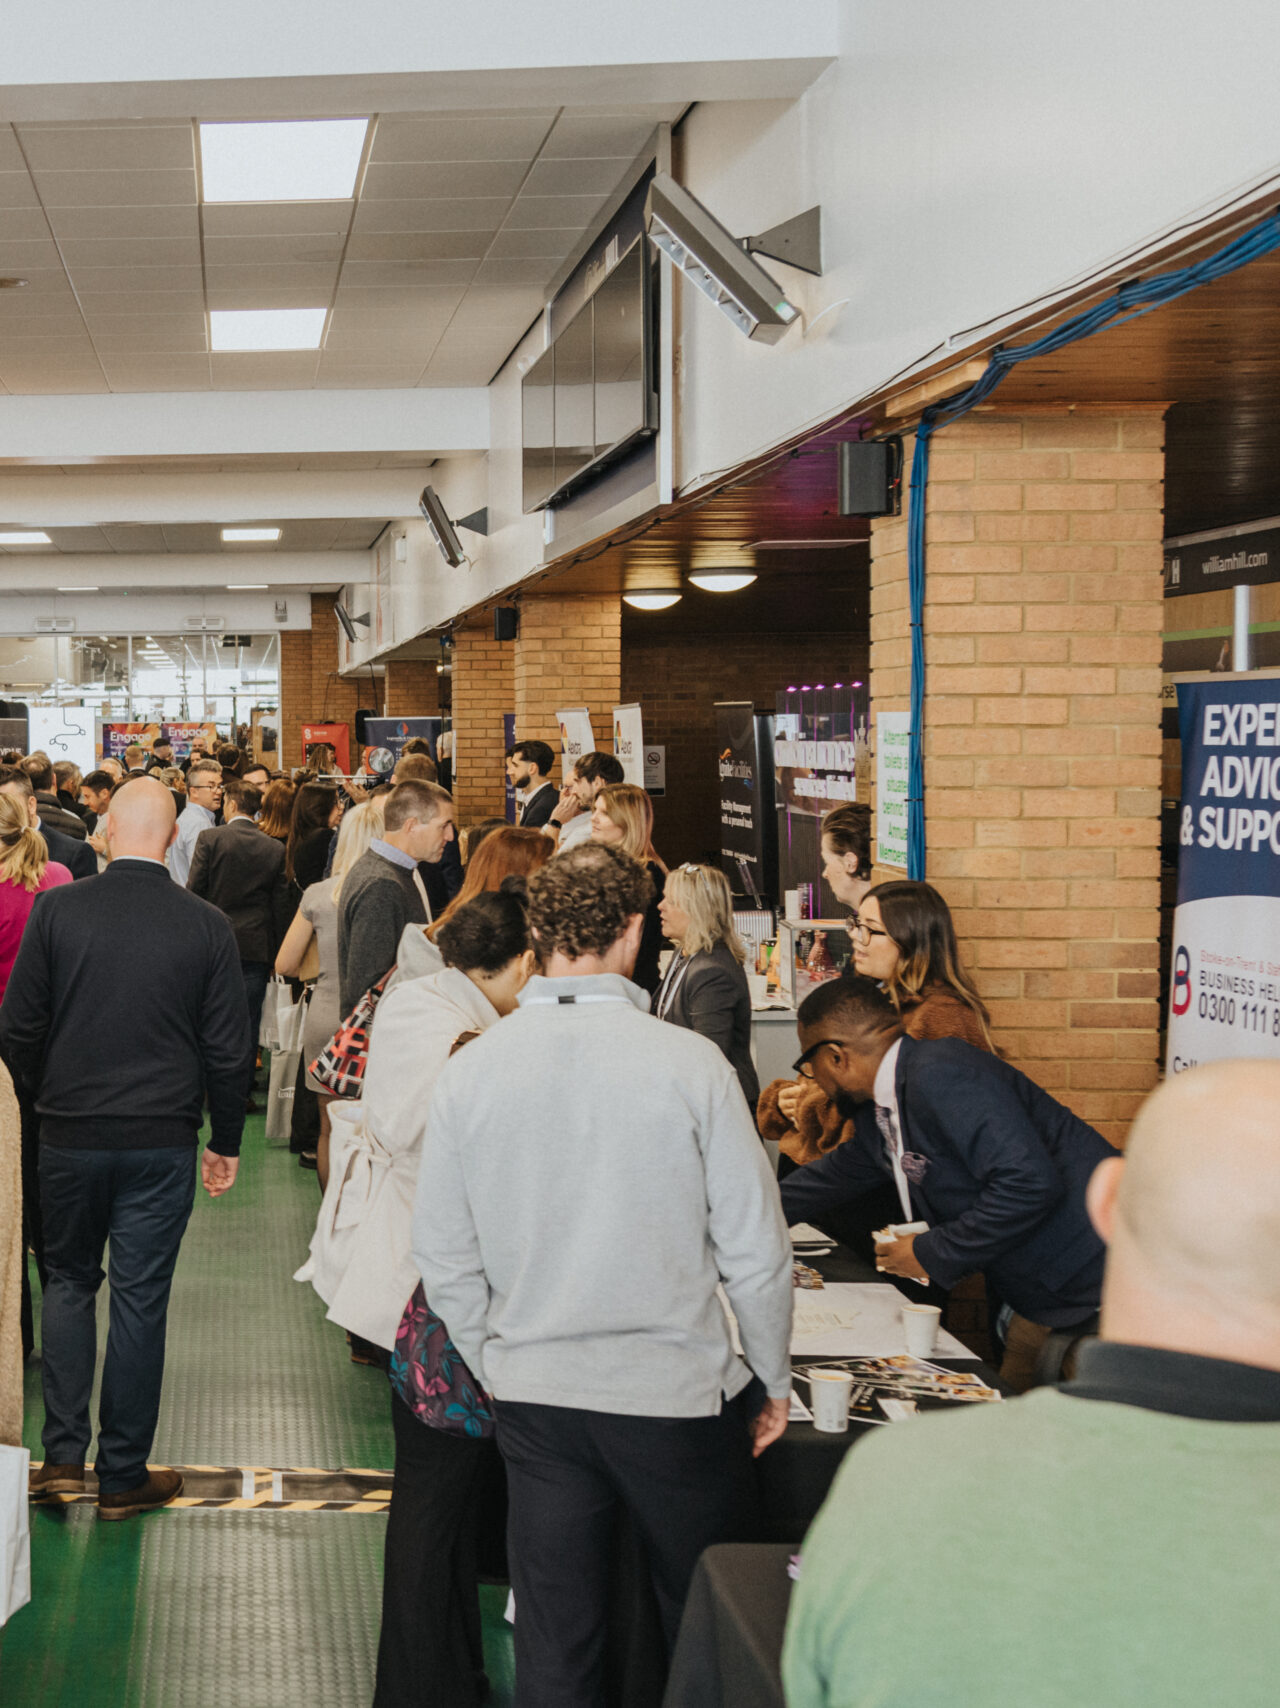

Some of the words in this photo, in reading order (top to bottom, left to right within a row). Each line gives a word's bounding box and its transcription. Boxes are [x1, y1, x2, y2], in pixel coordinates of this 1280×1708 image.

[1202, 551, 1268, 574] williamhill.com
[110, 731, 151, 744] Engage
[168, 727, 209, 739] Engage
[1179, 805, 1194, 846] &
[1200, 969, 1255, 997] BUSINESS
[1199, 991, 1235, 1026] 0300
[1242, 1001, 1268, 1034] 111
